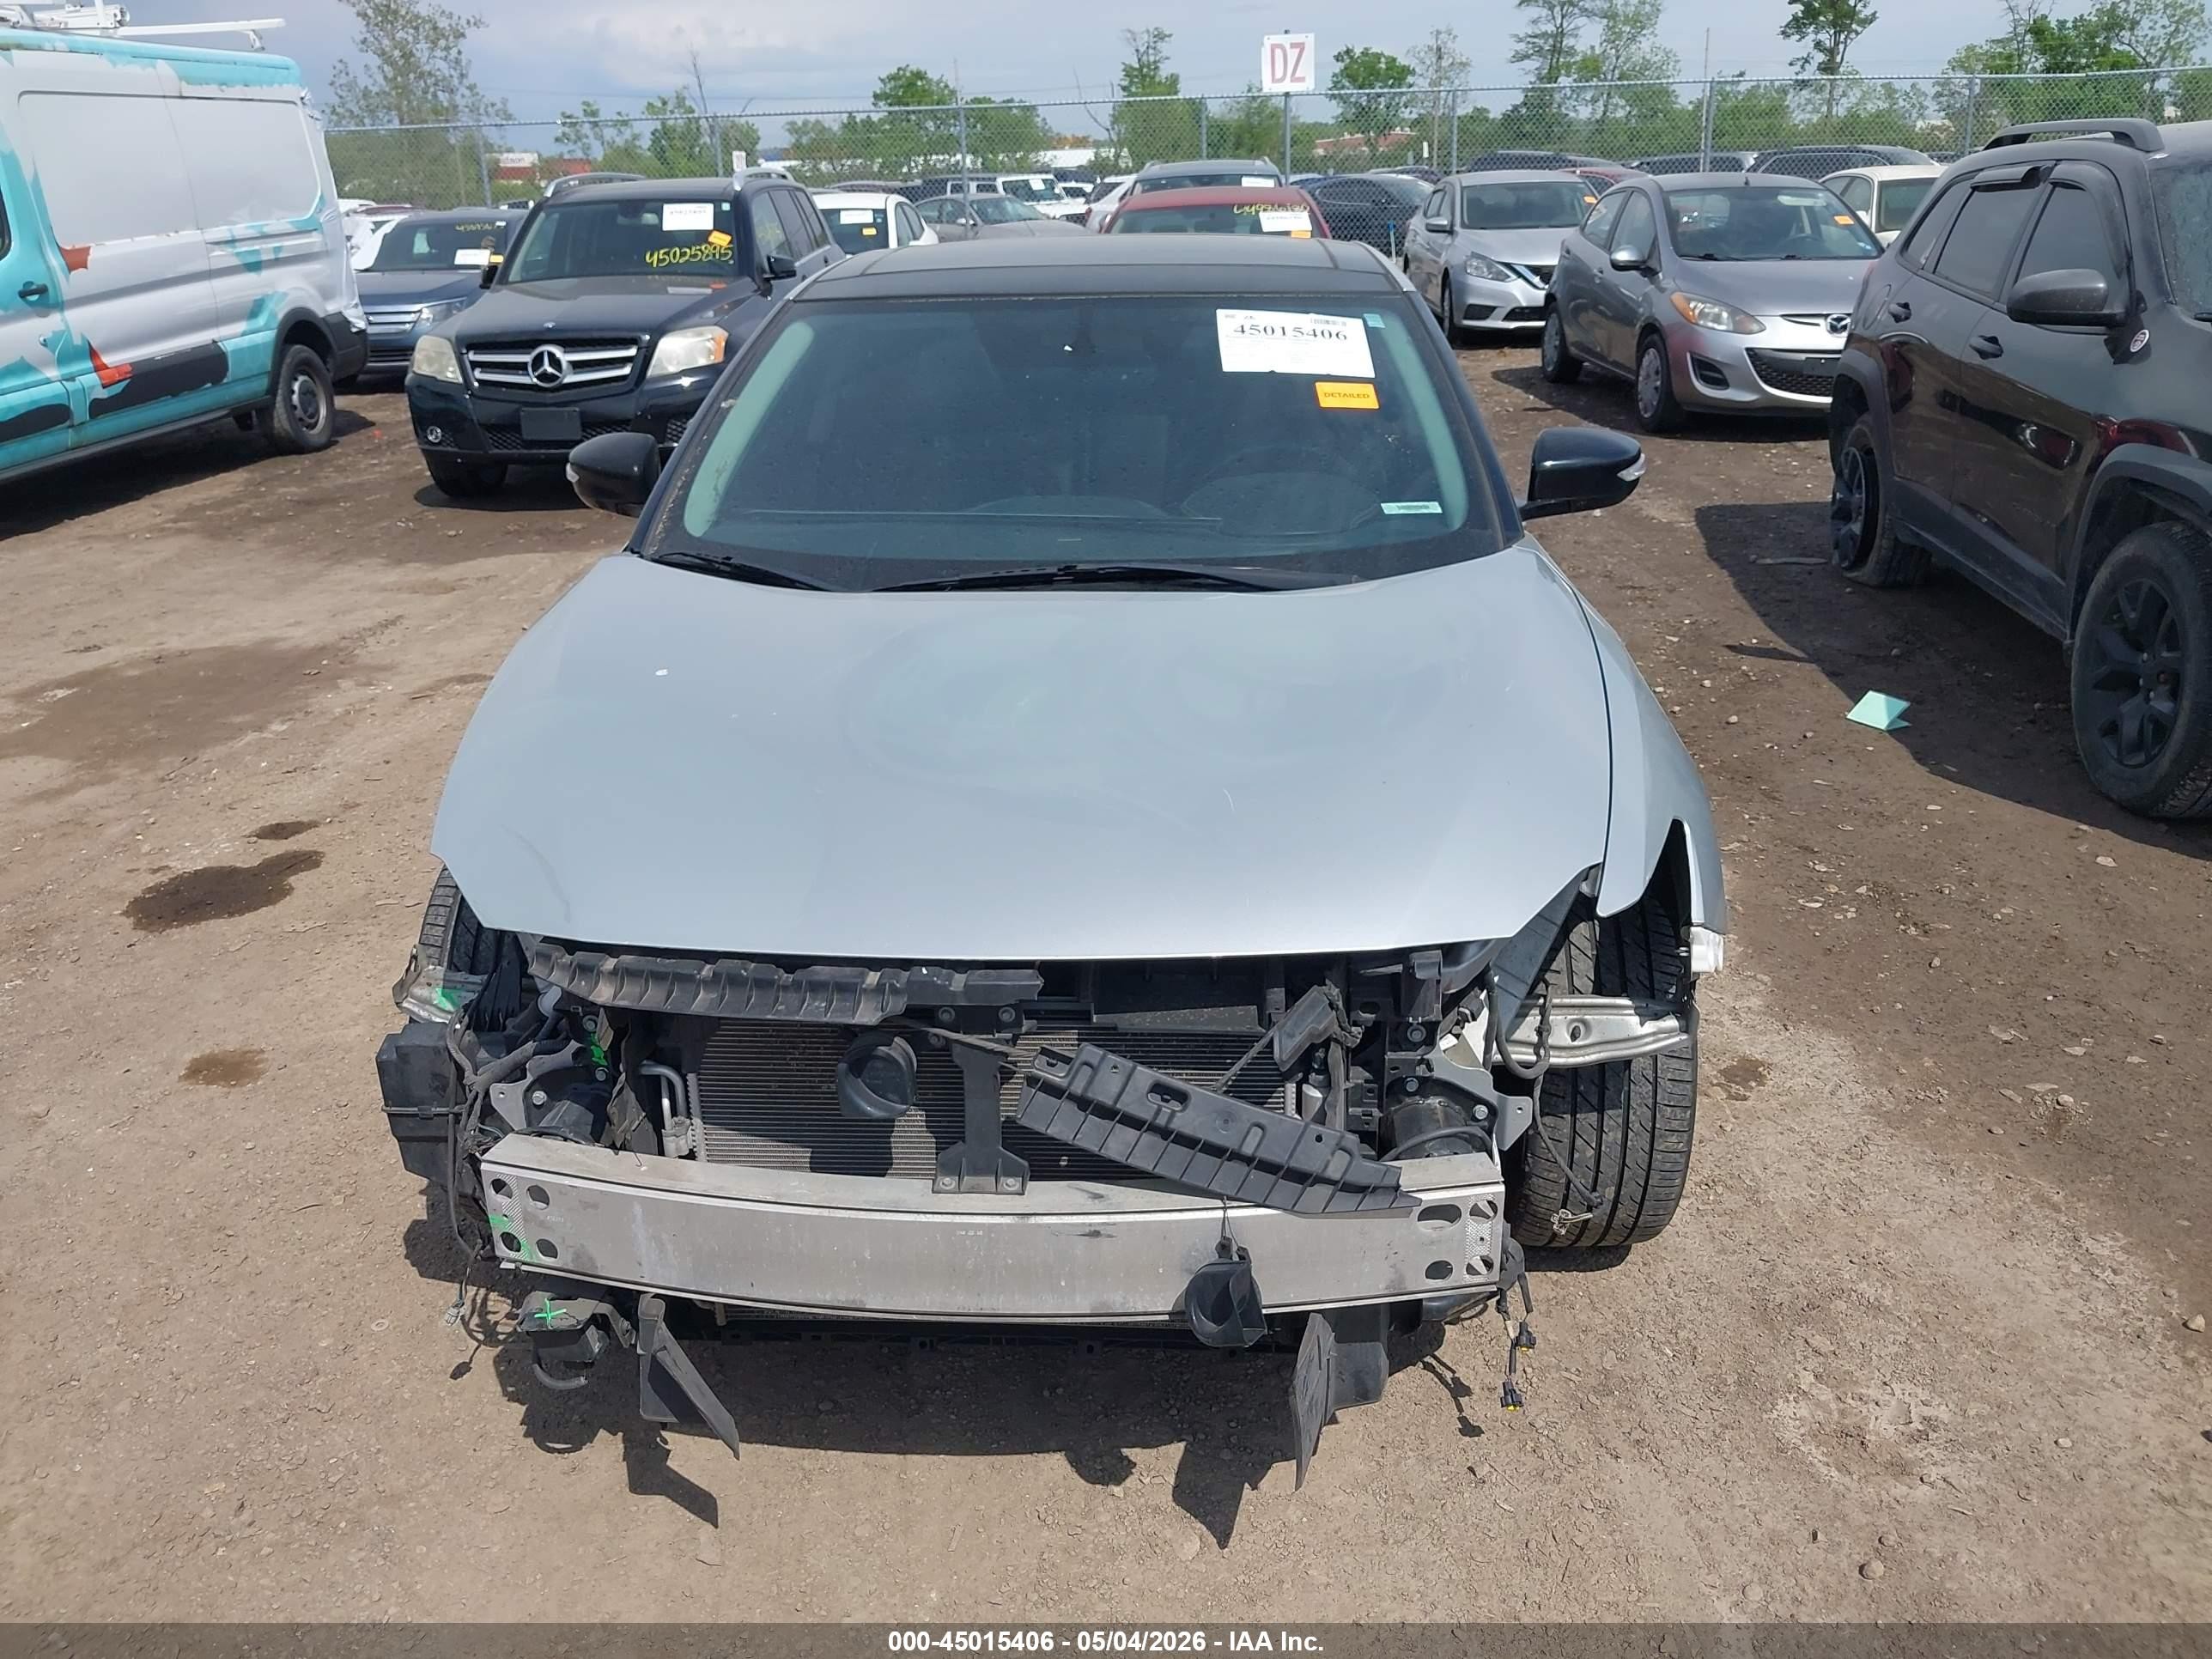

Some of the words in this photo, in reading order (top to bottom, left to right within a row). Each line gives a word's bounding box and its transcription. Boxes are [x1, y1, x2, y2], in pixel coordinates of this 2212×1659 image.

[1270, 41, 1305, 84] DZ
[645, 244, 733, 268] 45025895
[1233, 324, 1347, 341] 45015406
[1323, 392, 1371, 400] DETAILED
